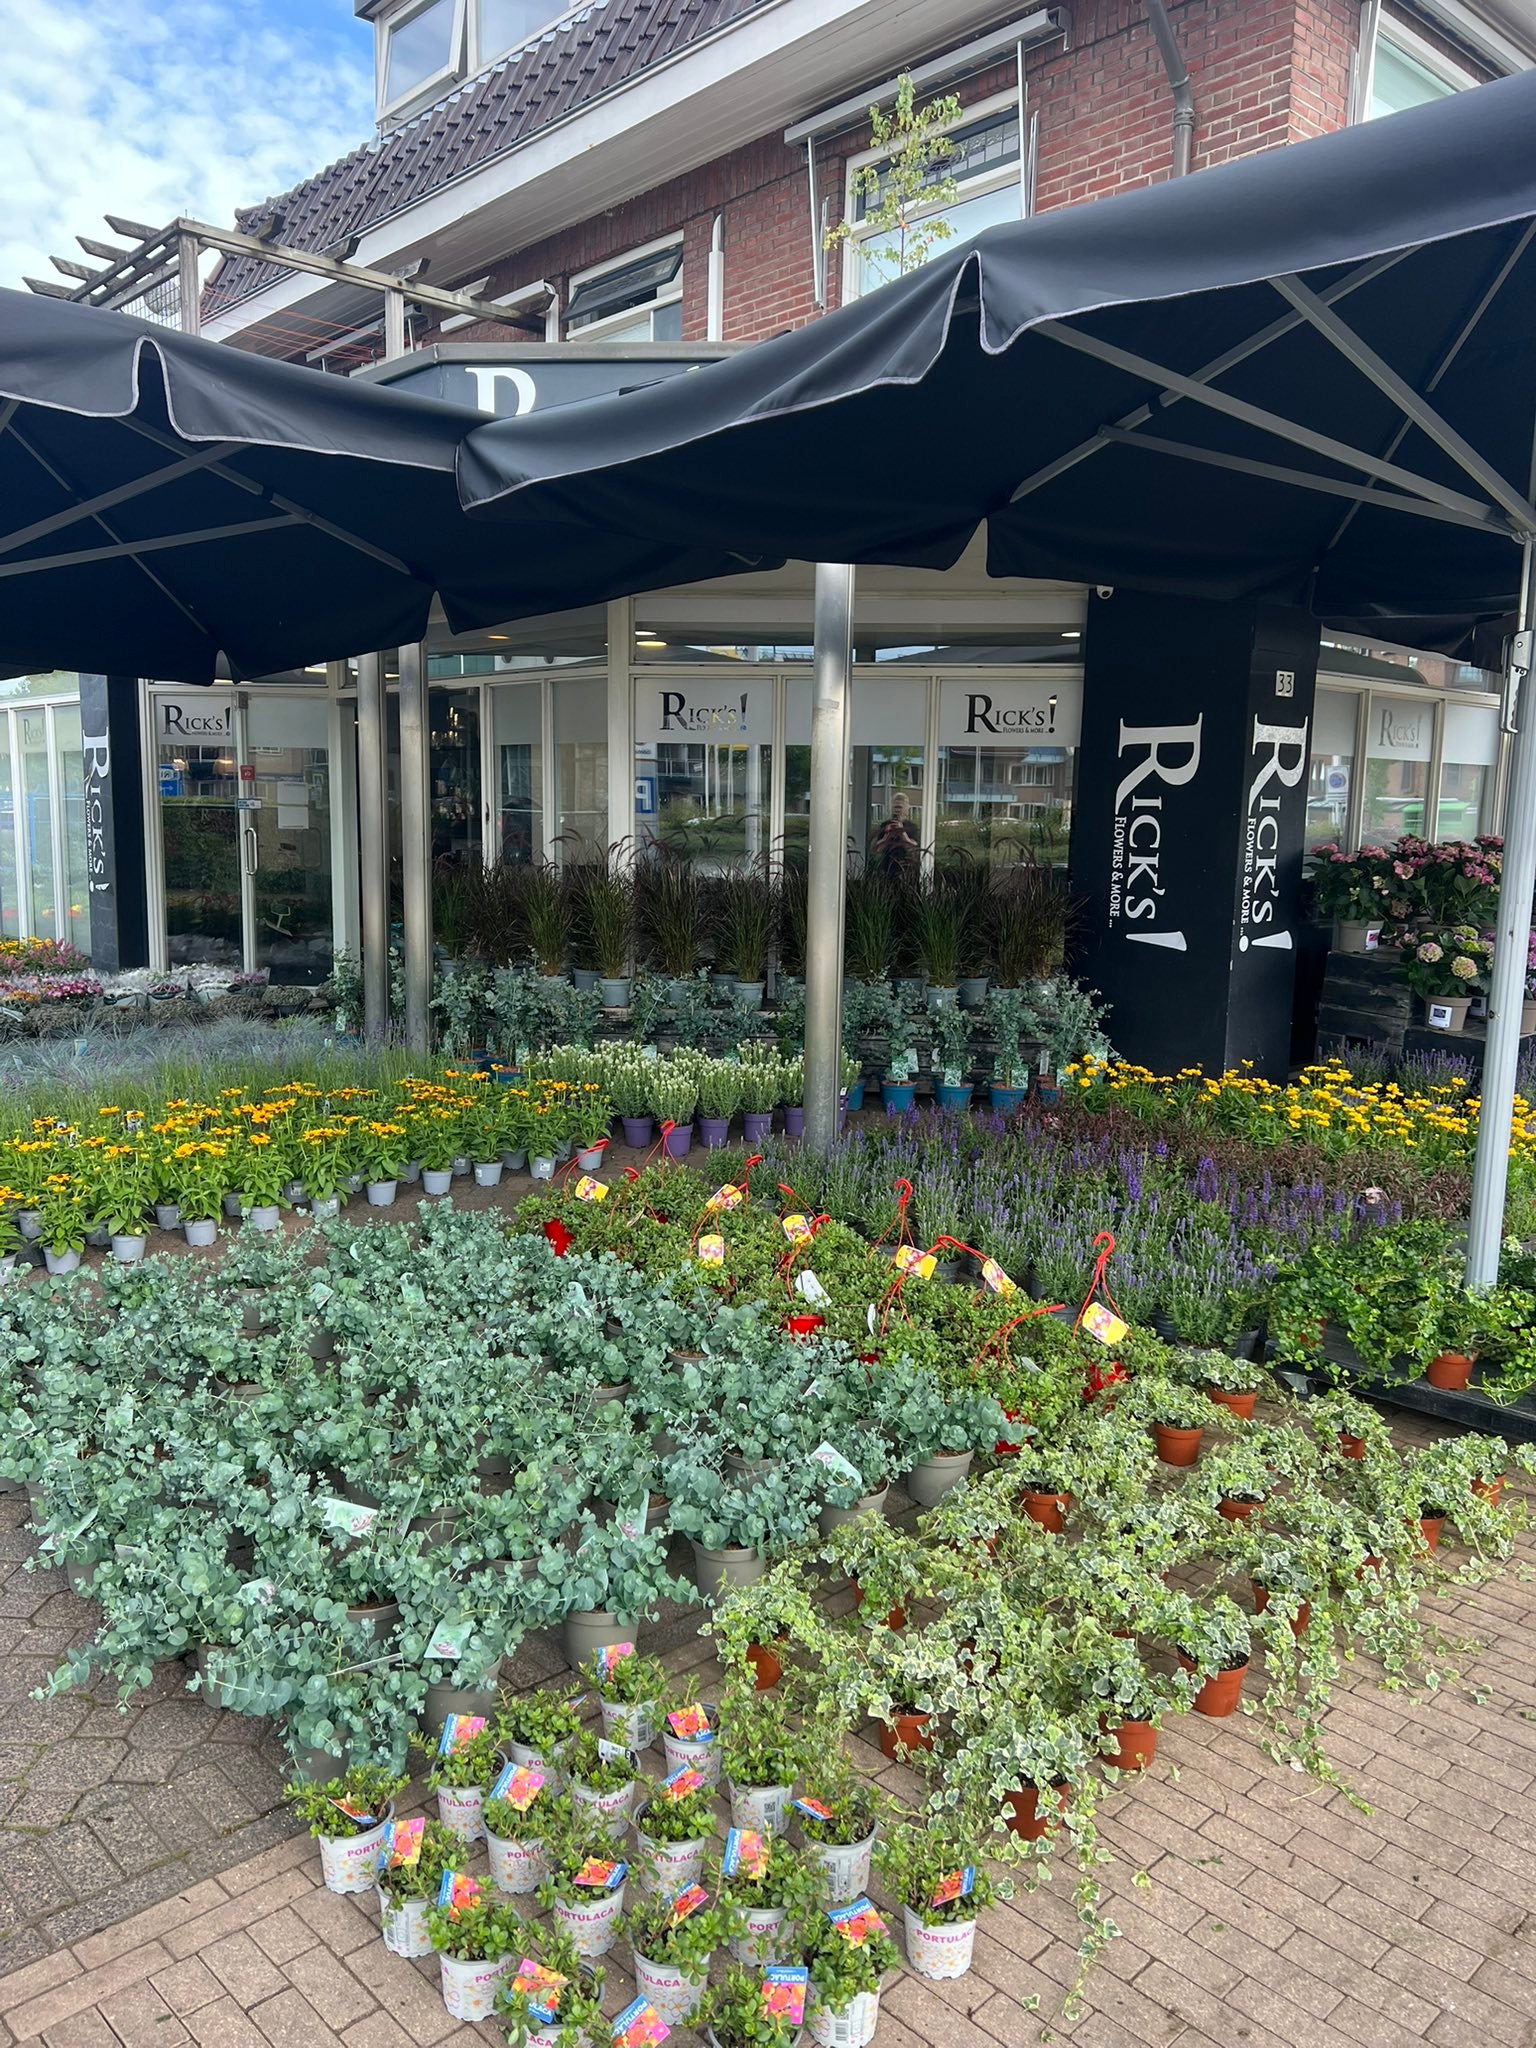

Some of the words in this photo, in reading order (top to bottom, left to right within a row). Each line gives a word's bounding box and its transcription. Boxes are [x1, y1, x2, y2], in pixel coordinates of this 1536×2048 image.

[1277, 673, 1293, 694] 33
[1112, 816, 1127, 869] FLOWERS
[1244, 817, 1256, 873] FLOWERS
[1111, 871, 1123, 881] &
[1242, 875, 1253, 888] &
[1109, 883, 1120, 917] MORE
[1240, 888, 1251, 924] MORE
